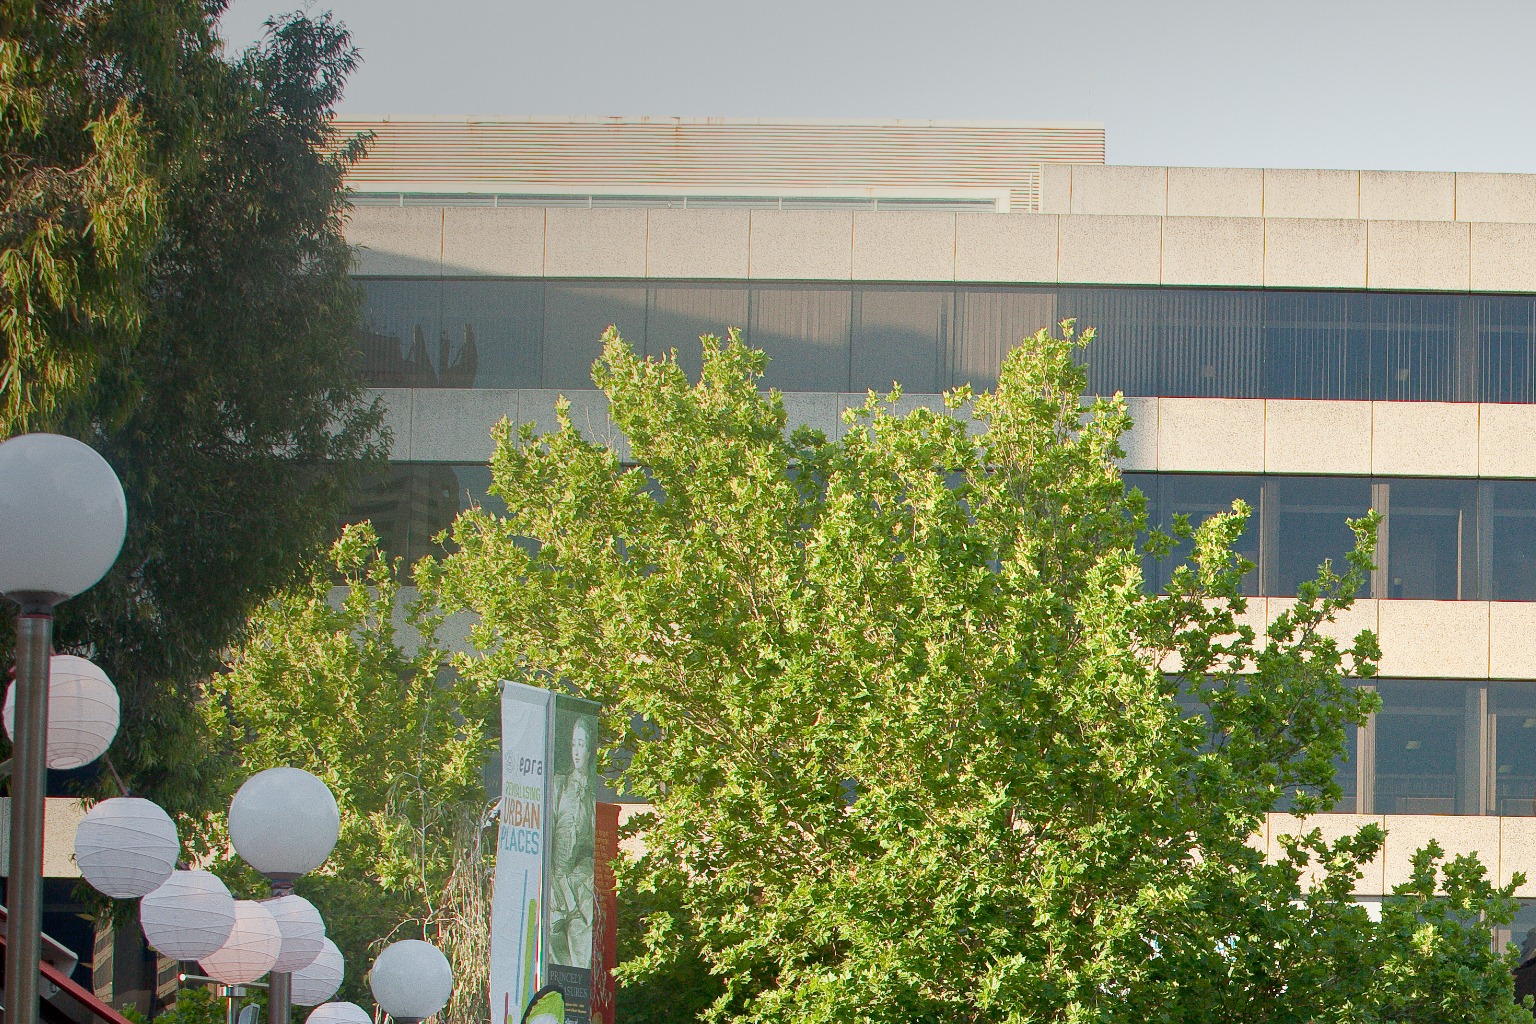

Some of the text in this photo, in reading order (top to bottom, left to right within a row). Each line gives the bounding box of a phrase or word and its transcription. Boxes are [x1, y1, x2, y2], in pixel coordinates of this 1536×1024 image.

[519, 756, 543, 776] epra
[503, 797, 541, 830] URBAN
[499, 825, 540, 855] PLACES
[550, 970, 583, 985] PRINCELY
